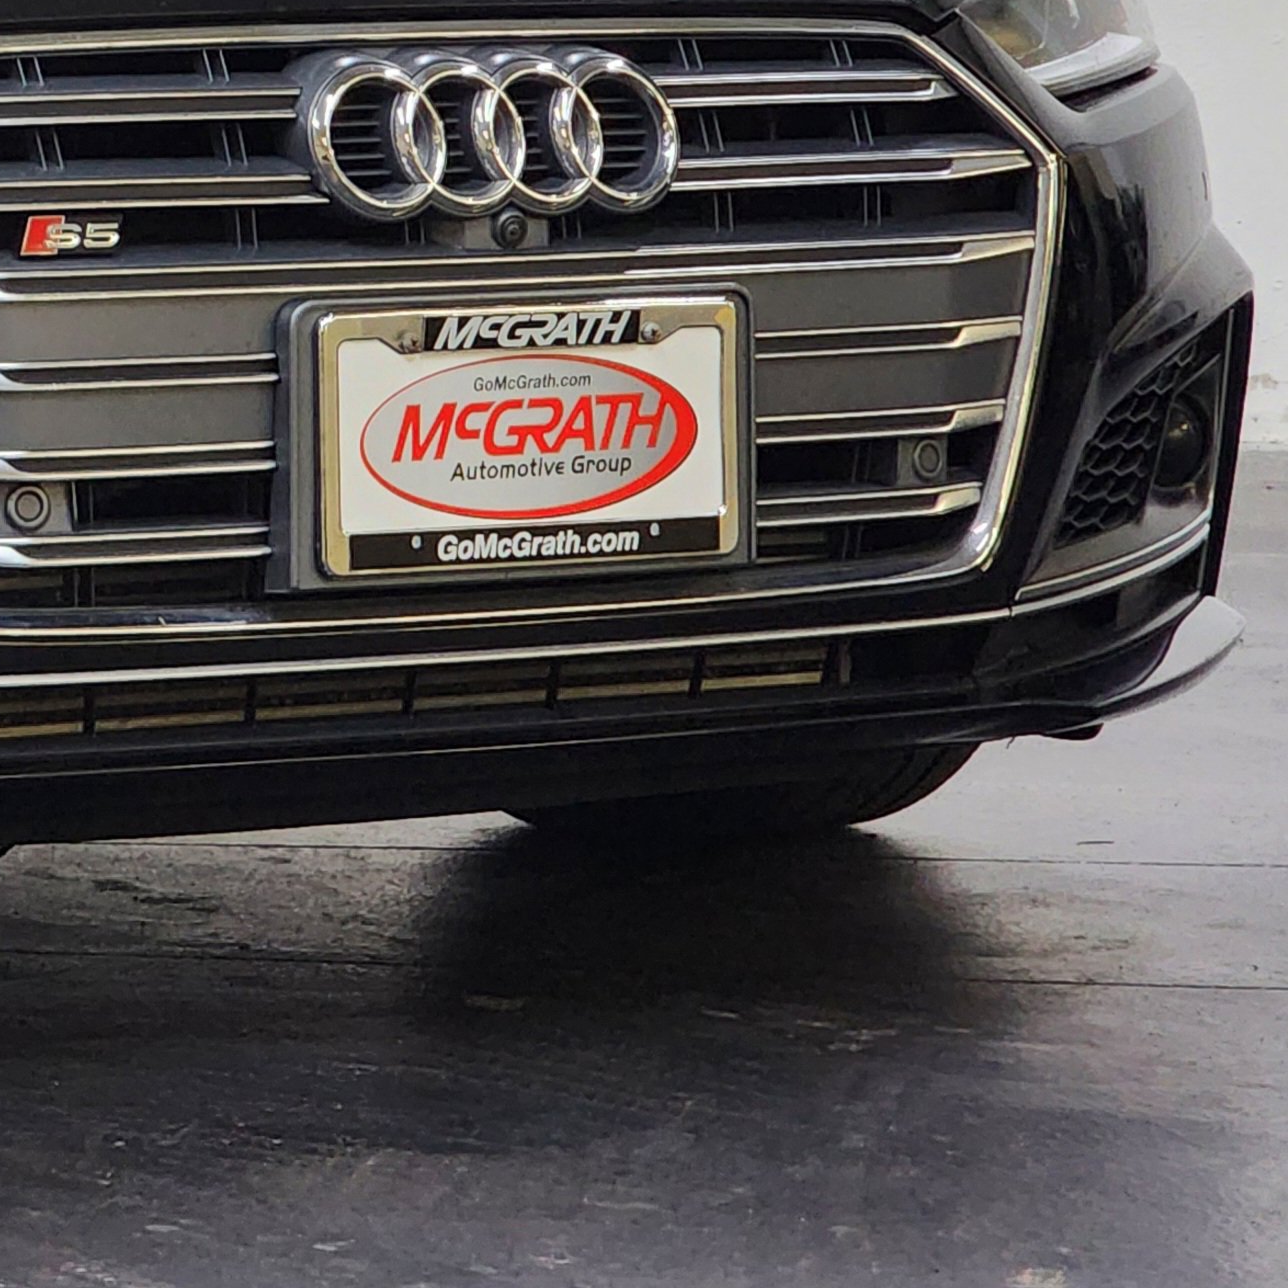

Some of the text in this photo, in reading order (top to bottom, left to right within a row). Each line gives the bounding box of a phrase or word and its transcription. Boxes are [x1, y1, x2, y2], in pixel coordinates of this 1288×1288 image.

[41, 219, 121, 251] S5
[473, 373, 592, 392] GoMcGrath.com
[450, 455, 633, 482] Automotive Group
[436, 529, 641, 562] GoMcGrath.com
